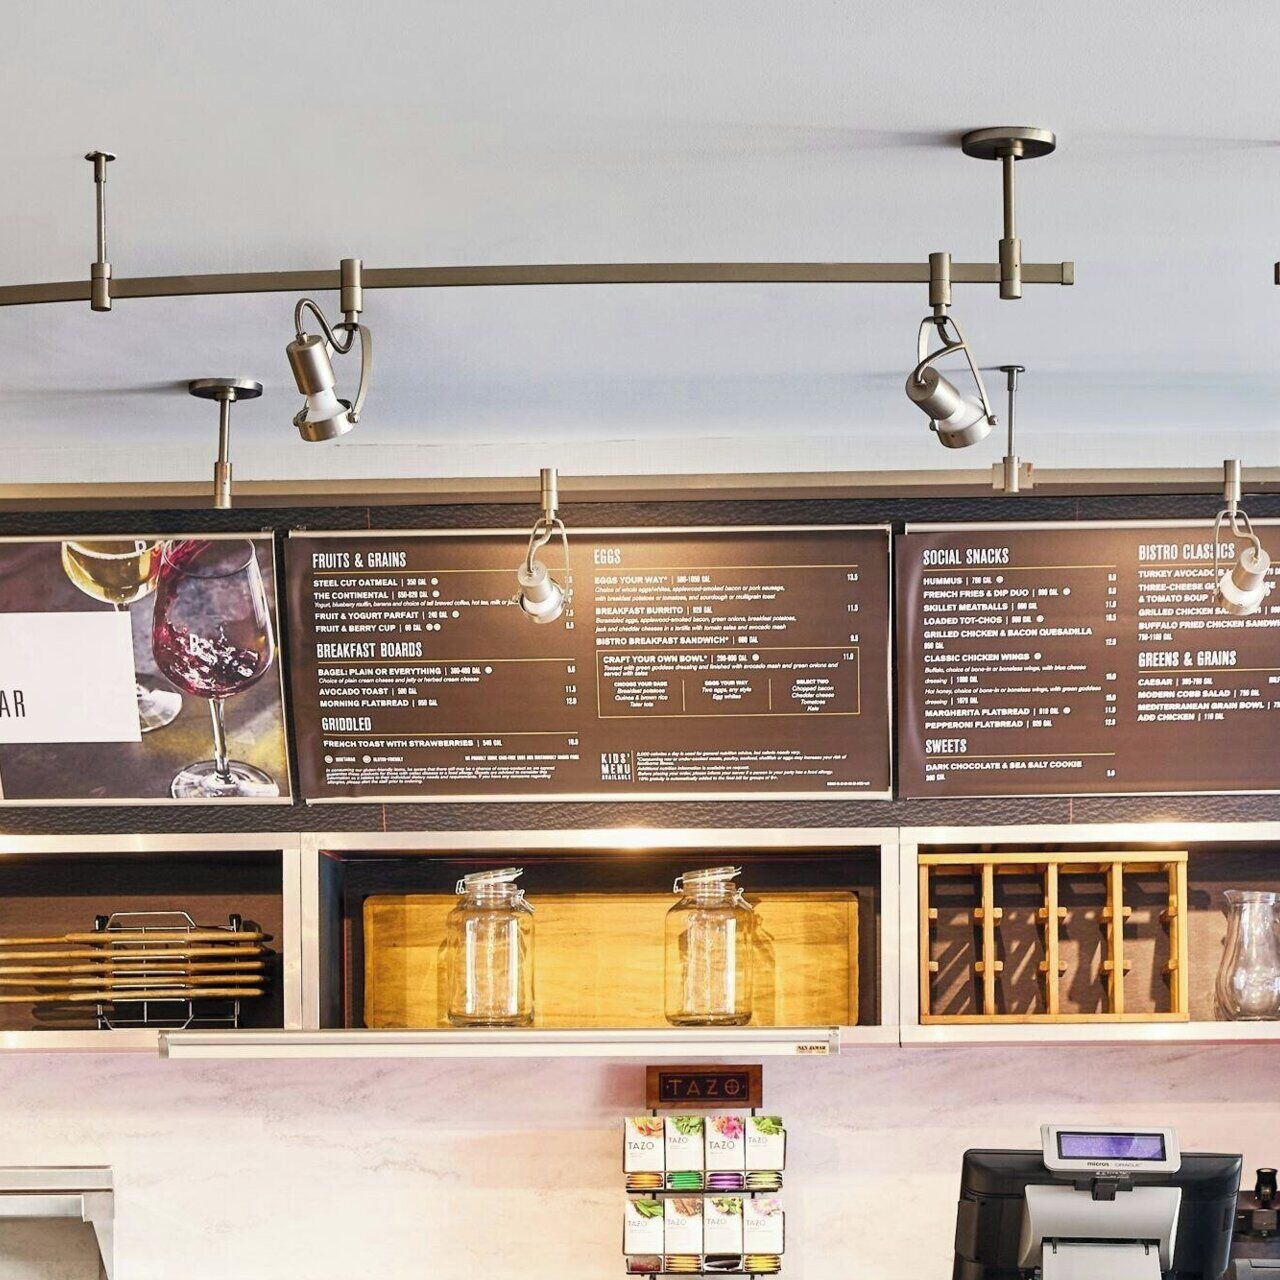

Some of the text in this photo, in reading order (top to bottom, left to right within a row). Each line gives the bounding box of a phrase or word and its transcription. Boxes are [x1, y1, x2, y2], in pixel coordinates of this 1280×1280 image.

[594, 548, 621, 564] EGGS
[923, 548, 1009, 565] SOCIAL SNACKS
[1138, 544, 1178, 560] BISTRO
[312, 551, 406, 568] FRUITS & GRAINS
[313, 578, 398, 587] STEEL CUT OATMEAL
[331, 591, 388, 599] CONTINENTAL
[340, 612, 346, 620] &
[383, 611, 419, 619] PARFAIT
[348, 624, 376, 632] BERRY
[316, 642, 422, 658] BREAKFAST BOARDS
[1138, 650, 1236, 667] GREENS & GRAINS
[318, 668, 347, 676] BAGEL:
[389, 667, 441, 675] EVERYTHING
[361, 687, 388, 695] TOAST
[321, 717, 371, 731] GRIDDLED
[408, 739, 474, 747] STRAWBERRIES
[925, 738, 966, 753] SWEETS
[669, 1079, 740, 1096] TAZO
[628, 1142, 655, 1150] TAZO
[710, 1141, 735, 1149] TAZO
